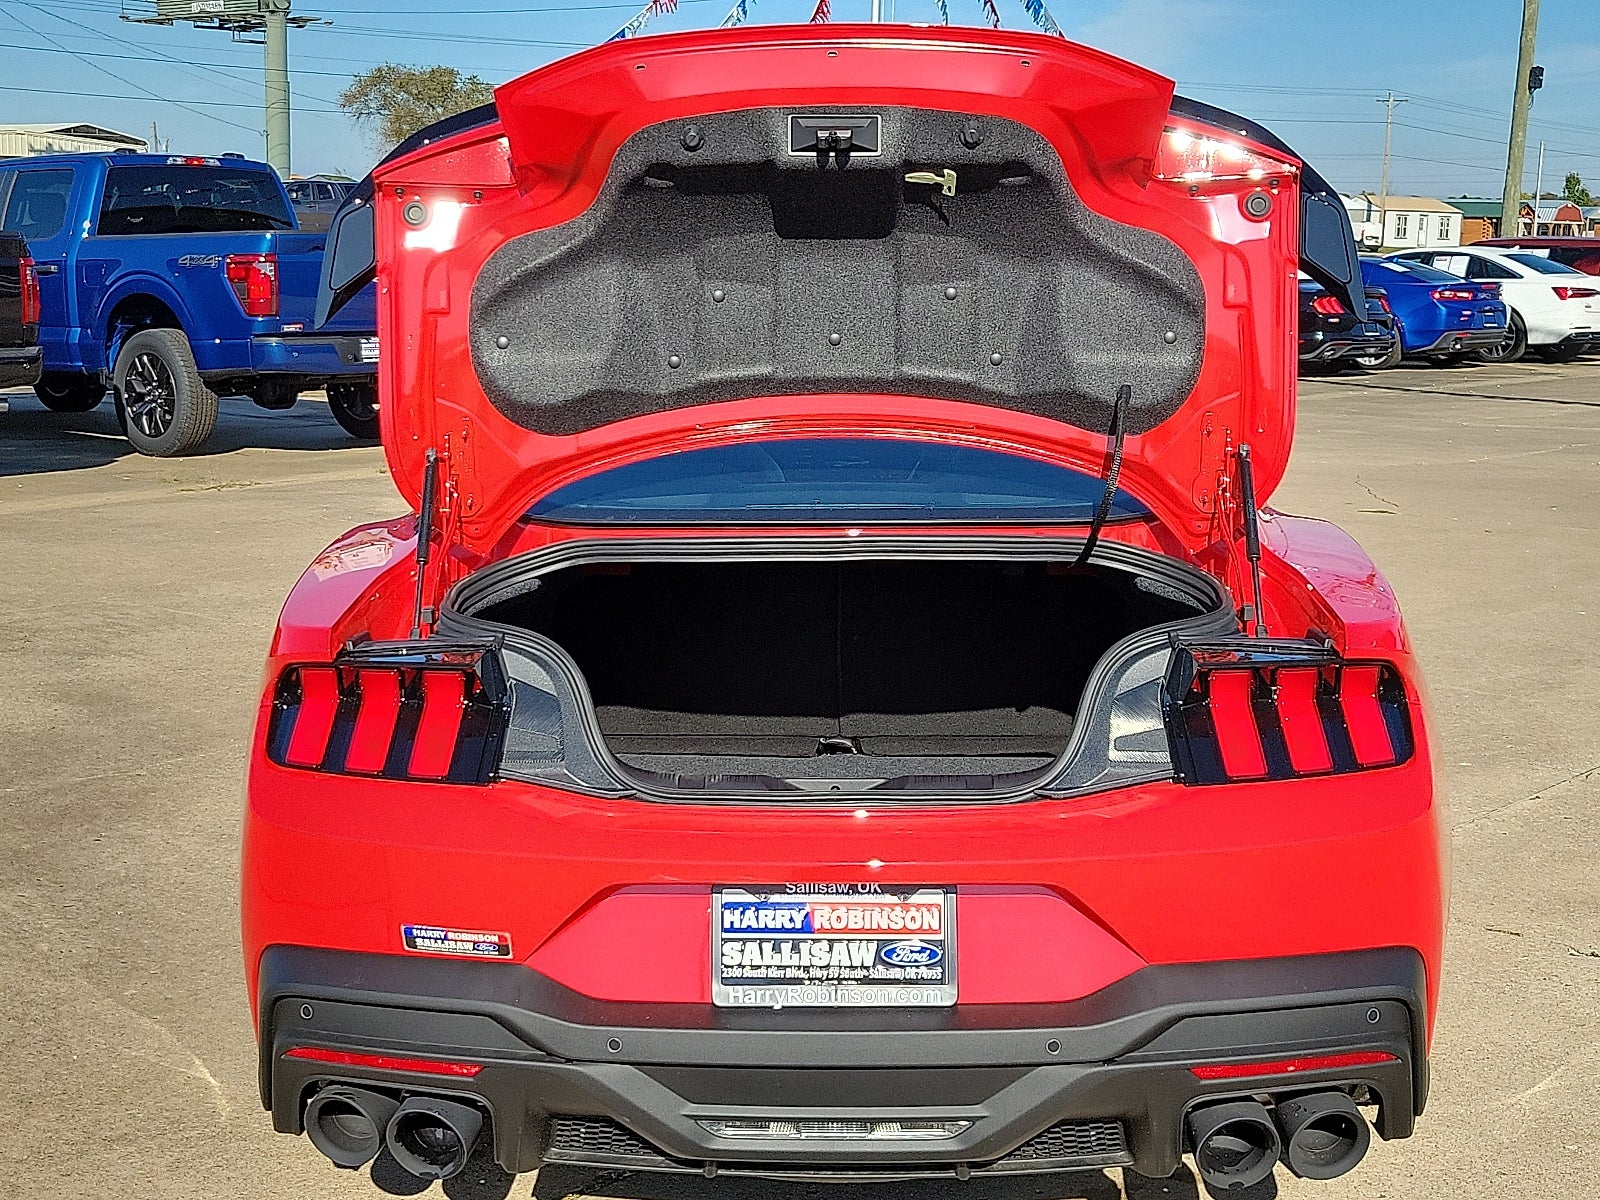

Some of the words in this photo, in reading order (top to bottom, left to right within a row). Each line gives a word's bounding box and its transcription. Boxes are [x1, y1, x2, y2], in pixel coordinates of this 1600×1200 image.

[785, 882, 853, 895] Sallisaw,
[857, 882, 882, 893] OK
[723, 907, 808, 929] HARRY
[813, 907, 941, 930] ROBINSON
[412, 928, 446, 939] HARRY
[447, 931, 499, 943] ROBINSON
[416, 938, 474, 951] SALLISAW
[722, 941, 877, 966] SALLISAW
[891, 945, 930, 963] Ford
[721, 966, 742, 978] 2300
[729, 986, 942, 1009] HarryRobinson.com
